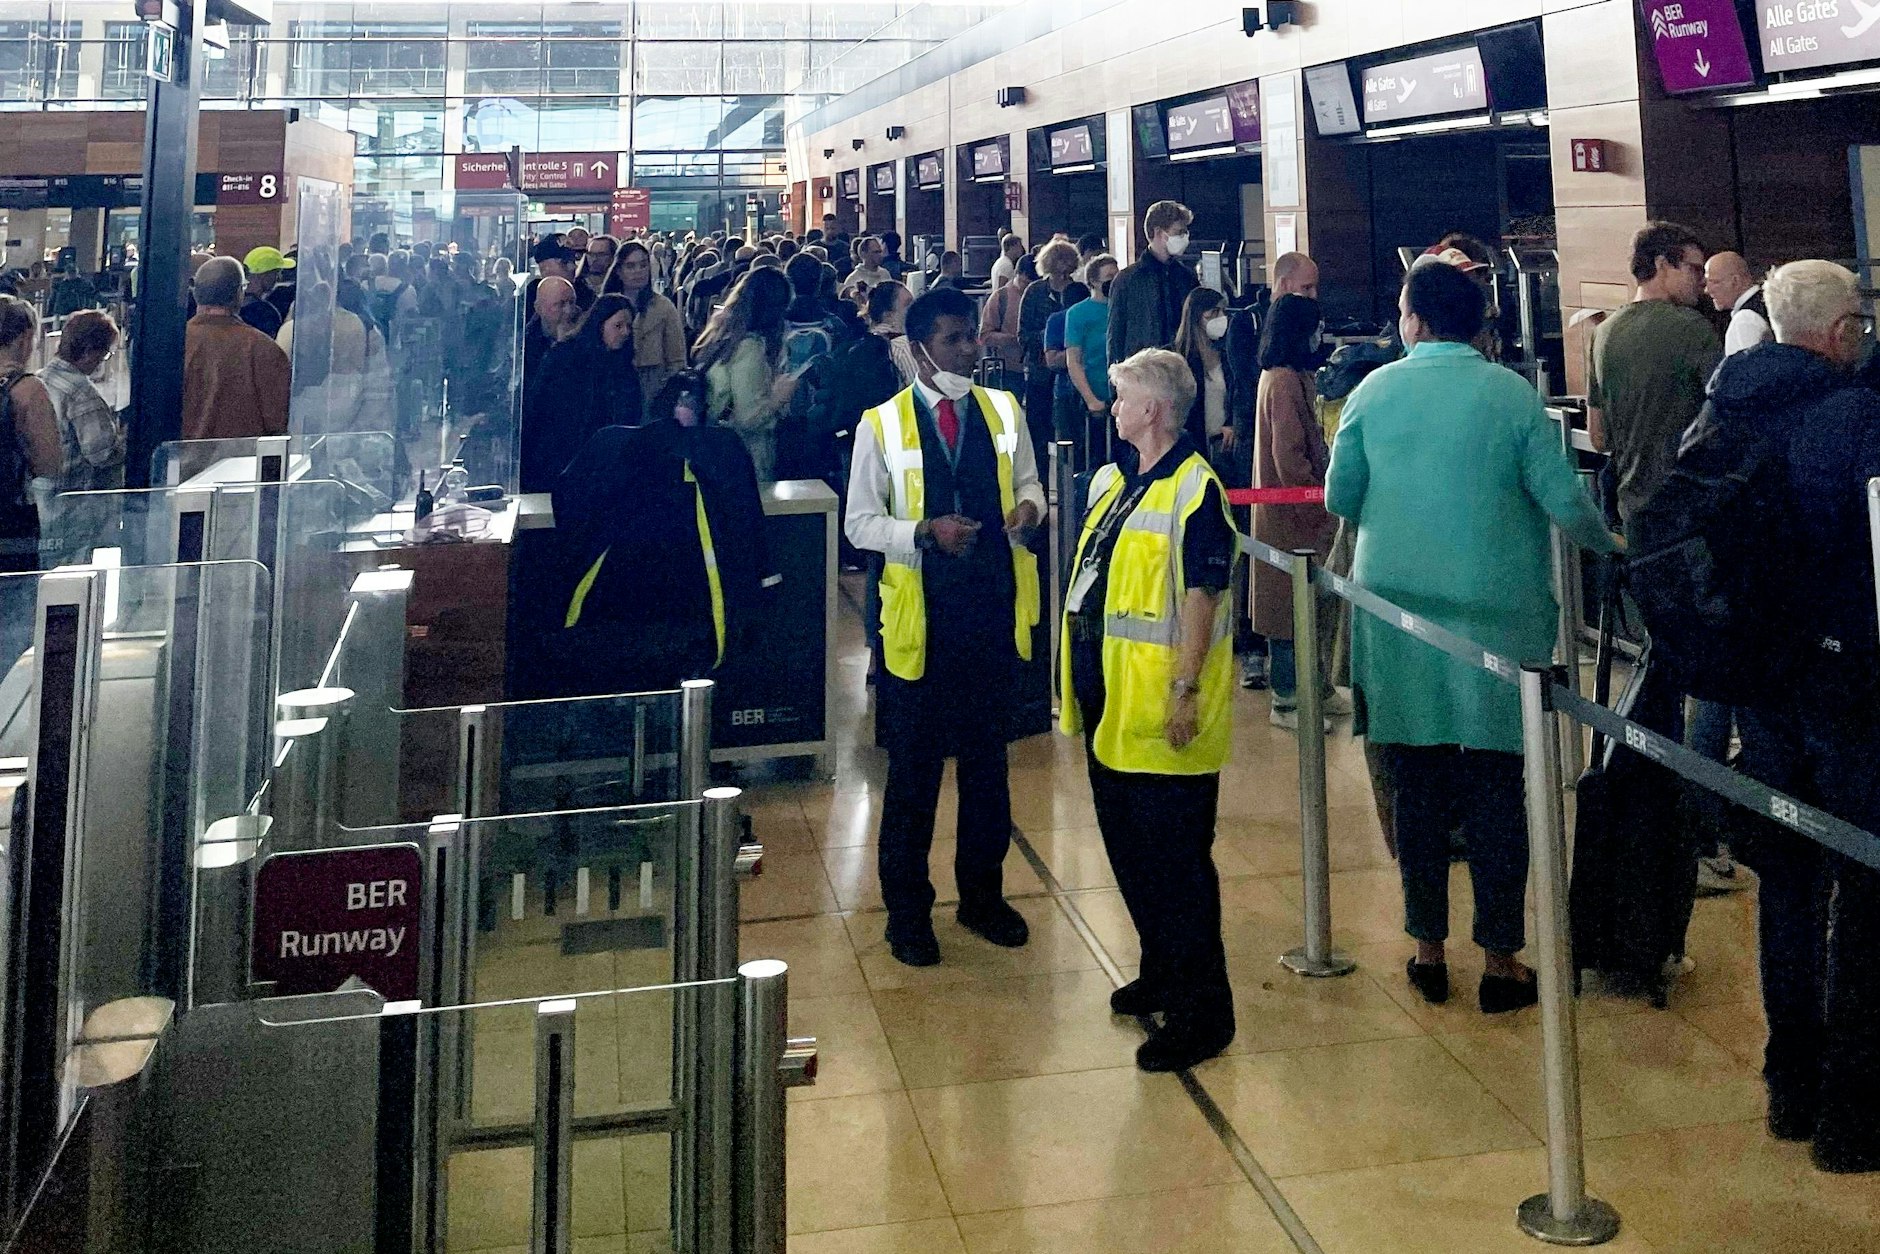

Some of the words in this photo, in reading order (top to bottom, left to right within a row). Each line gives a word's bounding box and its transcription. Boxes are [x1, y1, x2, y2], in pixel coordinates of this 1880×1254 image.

[1664, 4, 1684, 21] BER
[1766, 7, 1793, 29] Alle
[1796, 0, 1839, 23] Gates
[1668, 19, 1708, 39] Runway
[1770, 39, 1785, 57] All
[1787, 33, 1818, 55] Gates
[1365, 78, 1377, 94] Alle
[1378, 76, 1396, 92] Gates
[561, 162, 567, 171] 5
[260, 175, 276, 198] 8
[732, 708, 764, 725] BER
[1626, 725, 1646, 752] BER
[347, 879, 407, 910] BER
[280, 926, 406, 958] Runway
